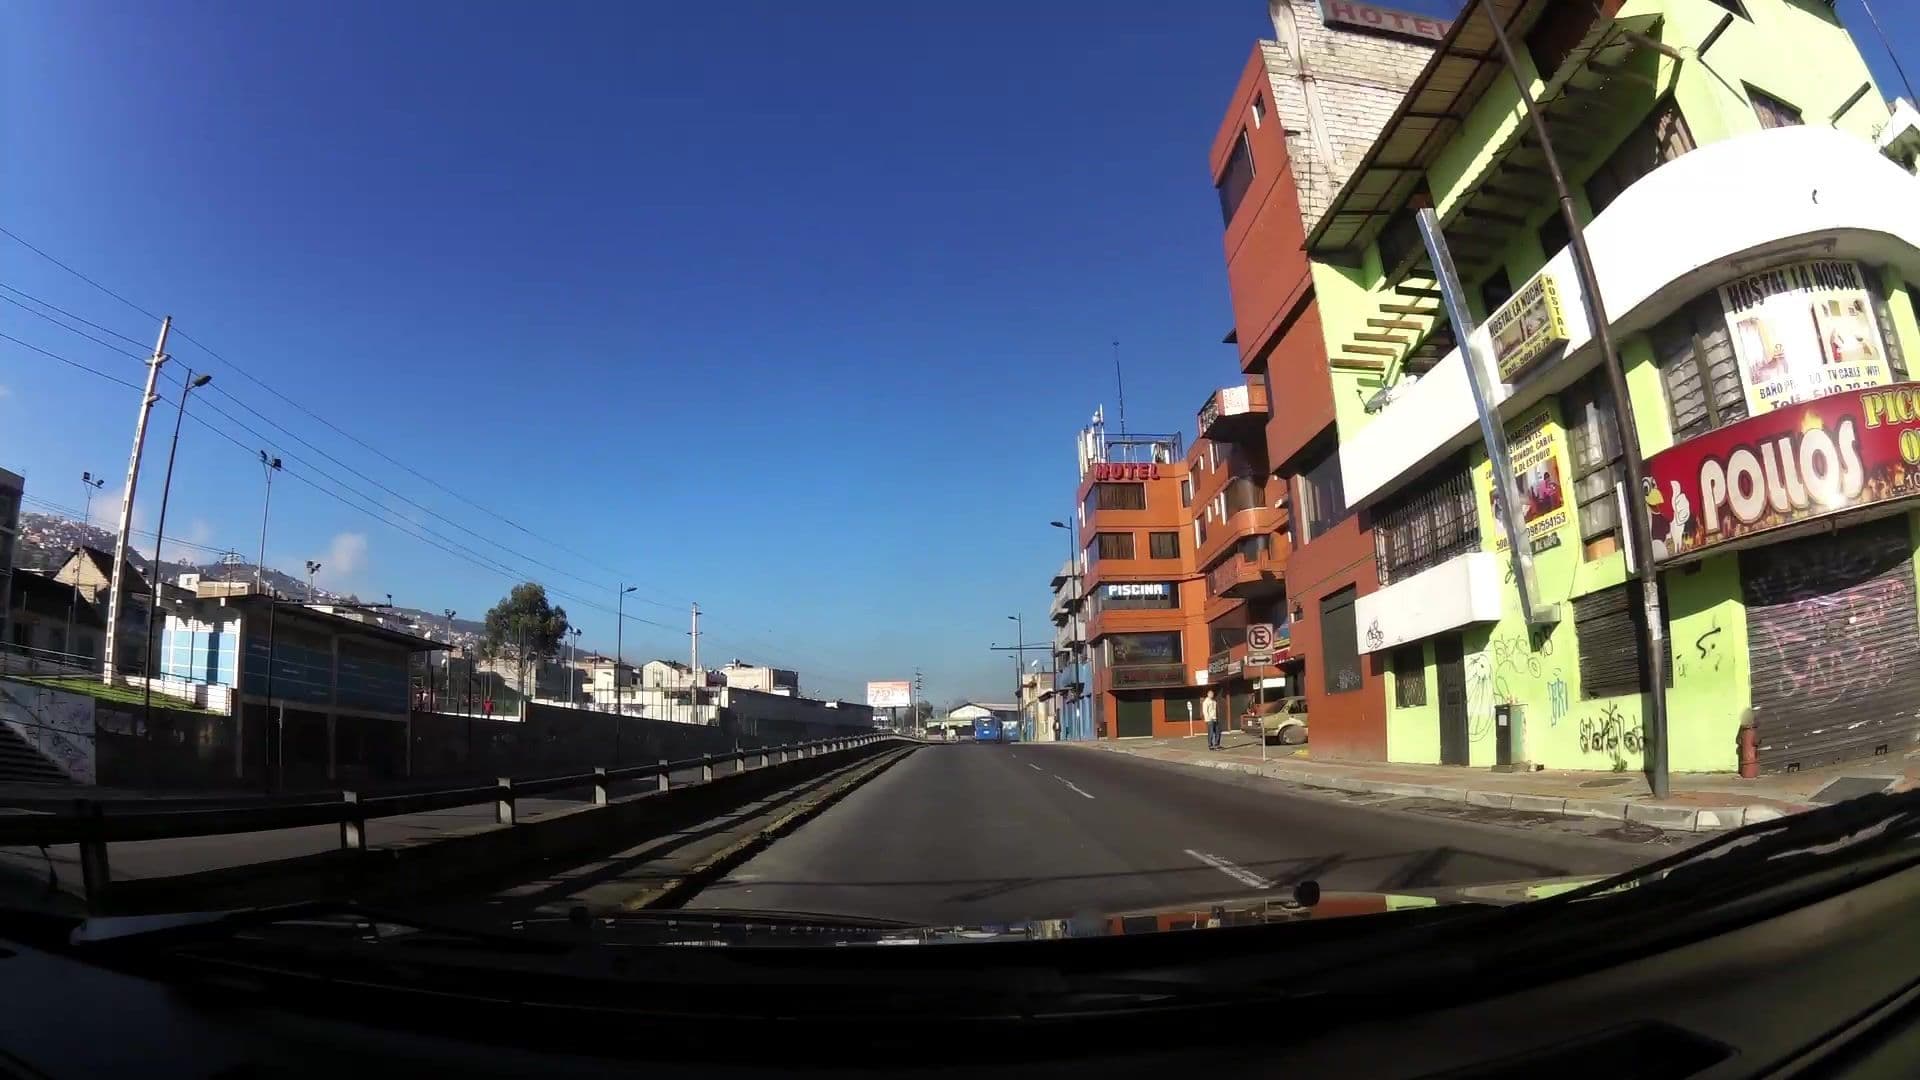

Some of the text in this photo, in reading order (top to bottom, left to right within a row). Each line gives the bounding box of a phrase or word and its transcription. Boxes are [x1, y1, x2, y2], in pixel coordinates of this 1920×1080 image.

[1489, 279, 1545, 338] HOSTAL LA NOCHE
[1545, 276, 1566, 336] HOSTAL
[1727, 262, 1859, 314] HOSTAL LA NOCHE
[1095, 463, 1161, 481] HOTEL
[1701, 420, 1864, 531] POLLOS
[1108, 584, 1163, 596] PISCINA
